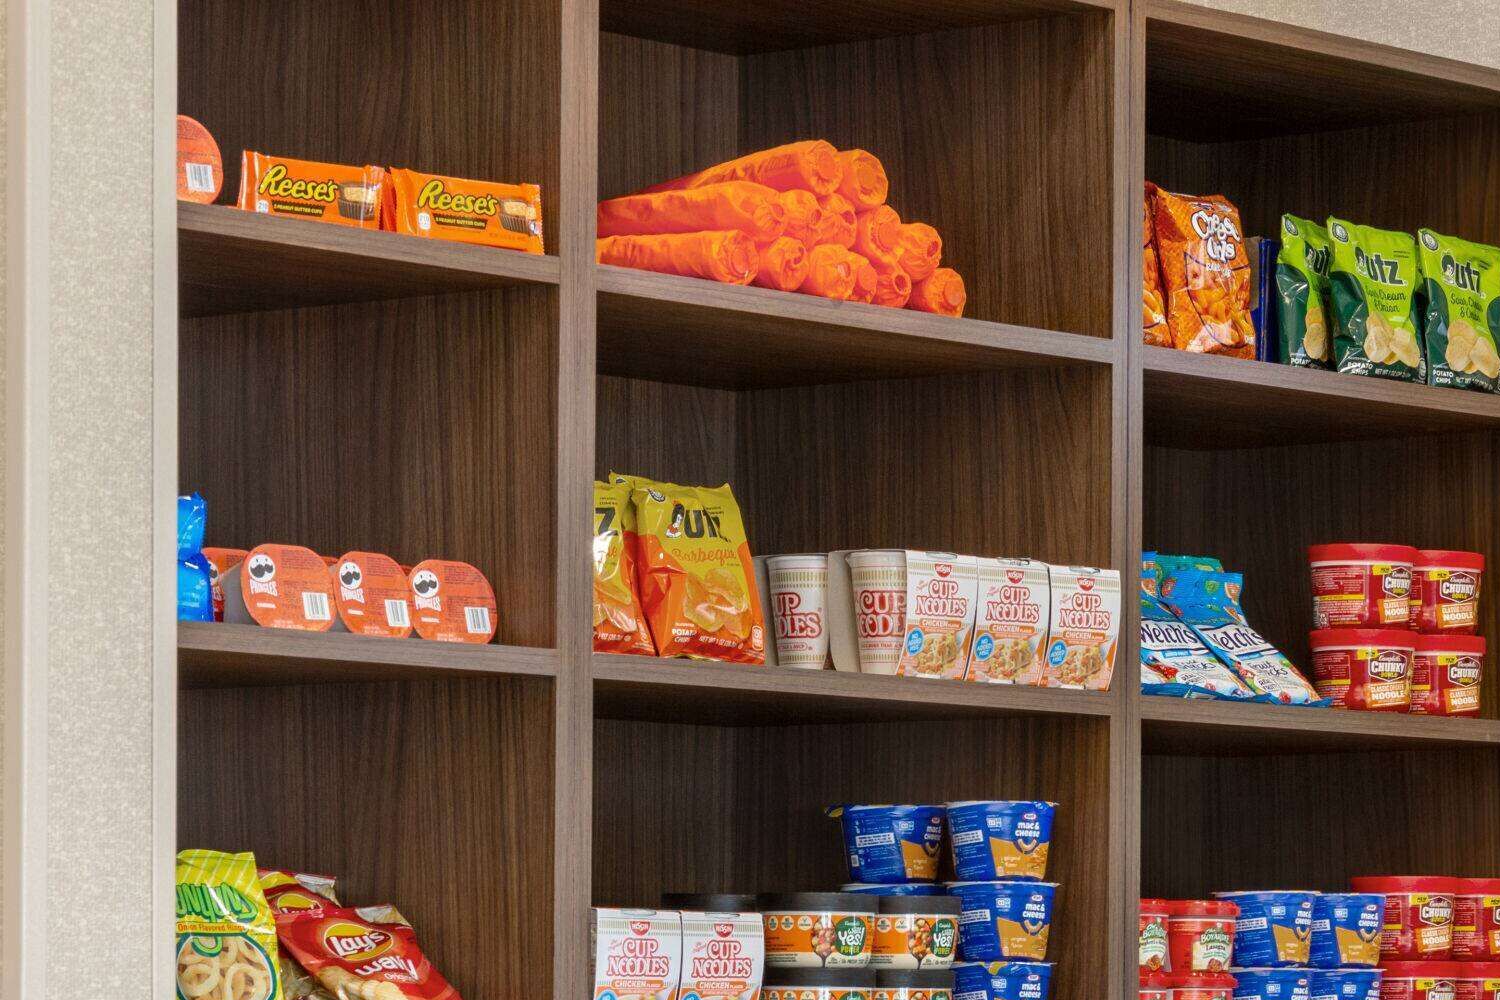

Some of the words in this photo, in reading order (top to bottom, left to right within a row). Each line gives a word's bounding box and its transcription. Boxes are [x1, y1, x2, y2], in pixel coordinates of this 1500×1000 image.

[258, 164, 339, 202] Reese's
[418, 180, 500, 216] Reese's
[1433, 369, 1454, 378] POTATO
[928, 579, 959, 599] CUP
[1000, 586, 1030, 604] CUP
[1442, 582, 1474, 594] CHUNKY
[915, 595, 968, 618] NOODLES
[1072, 593, 1101, 611] CUP
[985, 601, 1039, 623] NOODLES
[1059, 608, 1110, 630] NOODLES
[1443, 611, 1473, 621] NOODLE
[1141, 621, 1200, 644] Welch's
[1371, 660, 1405, 673] CHUNKY
[1450, 666, 1479, 679] CHUNKY
[1371, 690, 1405, 700] NOODLE
[1422, 906, 1452, 918] CHUNKY
[199, 923, 225, 931] Flavored
[329, 930, 386, 957] Lay's
[837, 927, 866, 946] Yes!
[933, 929, 954, 947] Yes!
[622, 937, 659, 958] CUP
[706, 939, 742, 959] CUP
[606, 956, 670, 977] NOODLES
[691, 957, 753, 979] NOODLES
[614, 980, 646, 988] CHICKEN
[699, 981, 730, 990] CHICKEN
